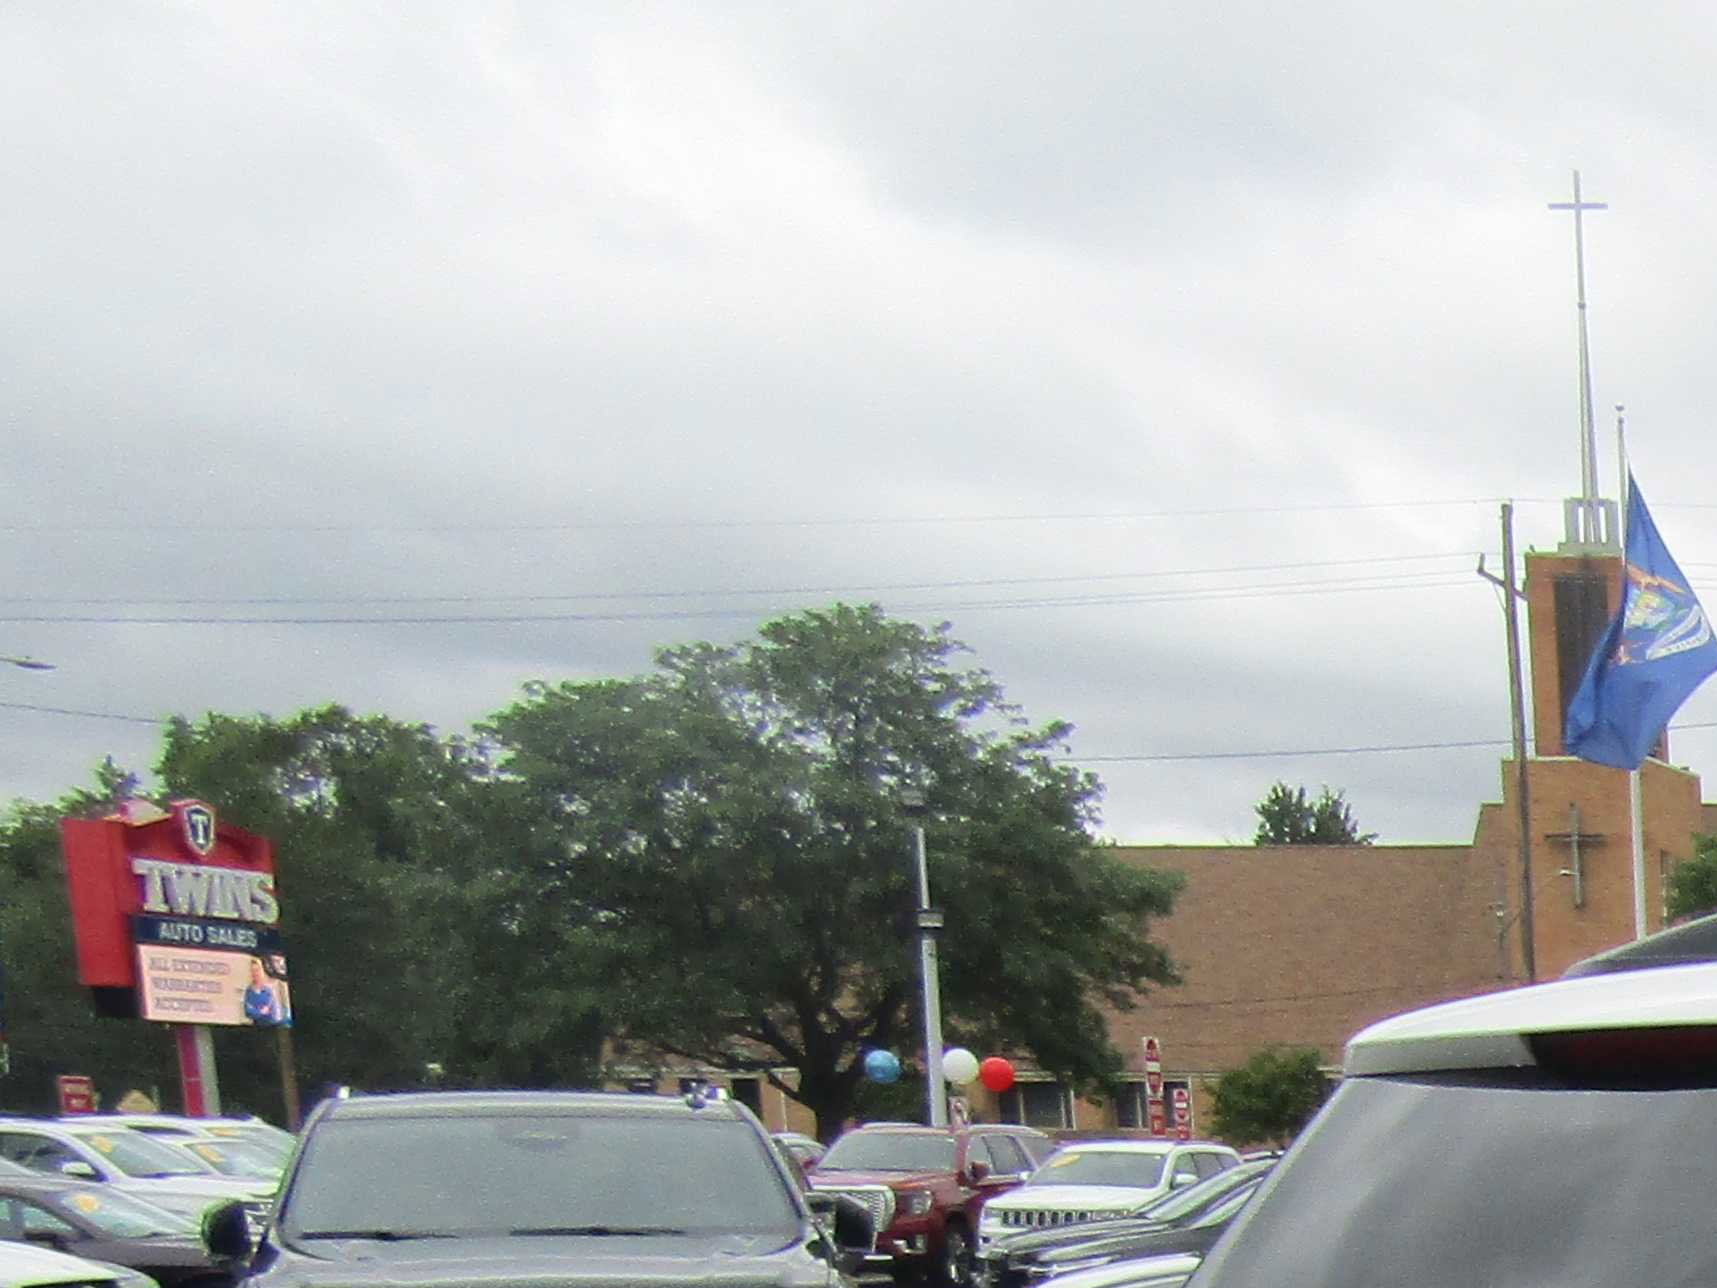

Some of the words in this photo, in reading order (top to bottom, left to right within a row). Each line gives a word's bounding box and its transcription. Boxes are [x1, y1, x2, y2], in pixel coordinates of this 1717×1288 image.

[191, 814, 208, 844] T
[131, 857, 280, 924] TWINS
[160, 922, 203, 942] AUTO
[206, 926, 257, 948] SALES
